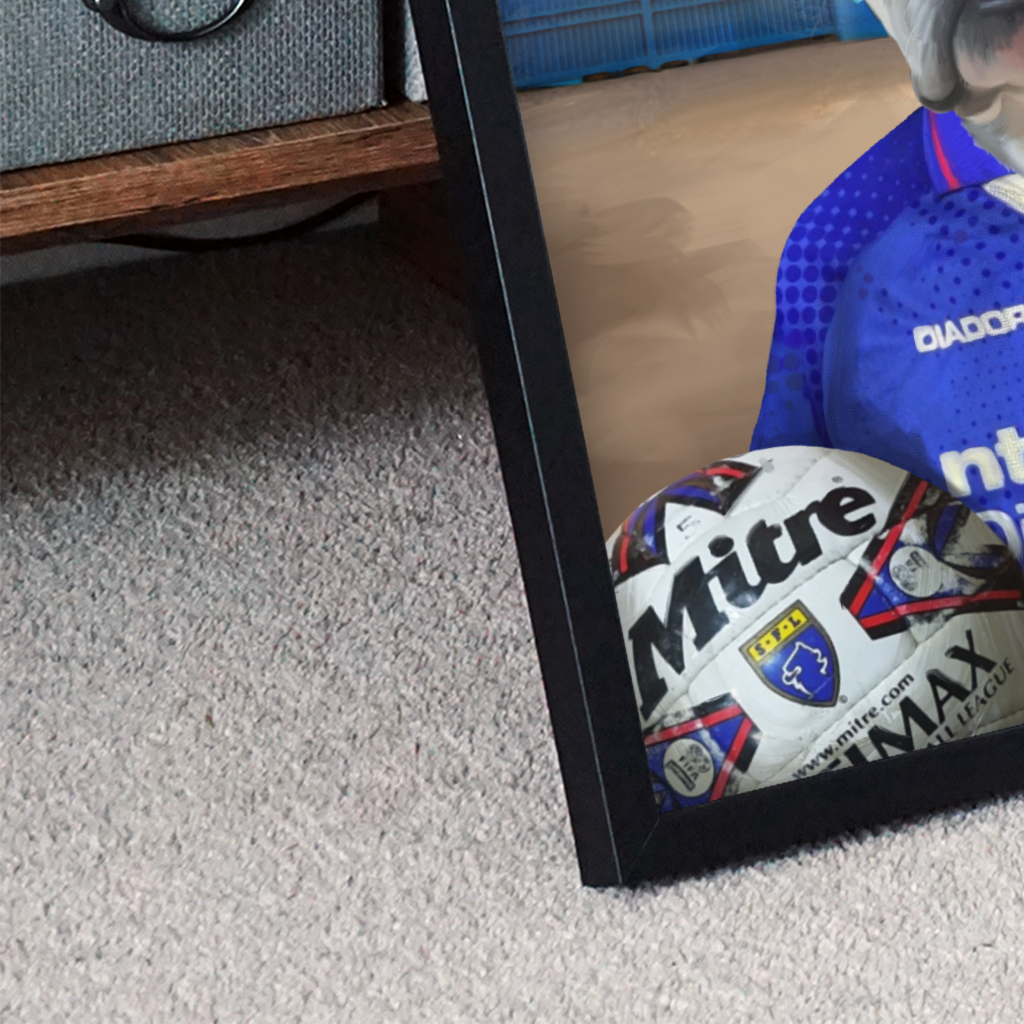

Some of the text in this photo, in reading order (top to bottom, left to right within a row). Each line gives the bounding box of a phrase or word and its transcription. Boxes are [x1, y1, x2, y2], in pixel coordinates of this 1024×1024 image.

[628, 486, 877, 722] Mitre
[792, 672, 916, 780] www.mitre.com
[956, 657, 1016, 726] LEAGUE
